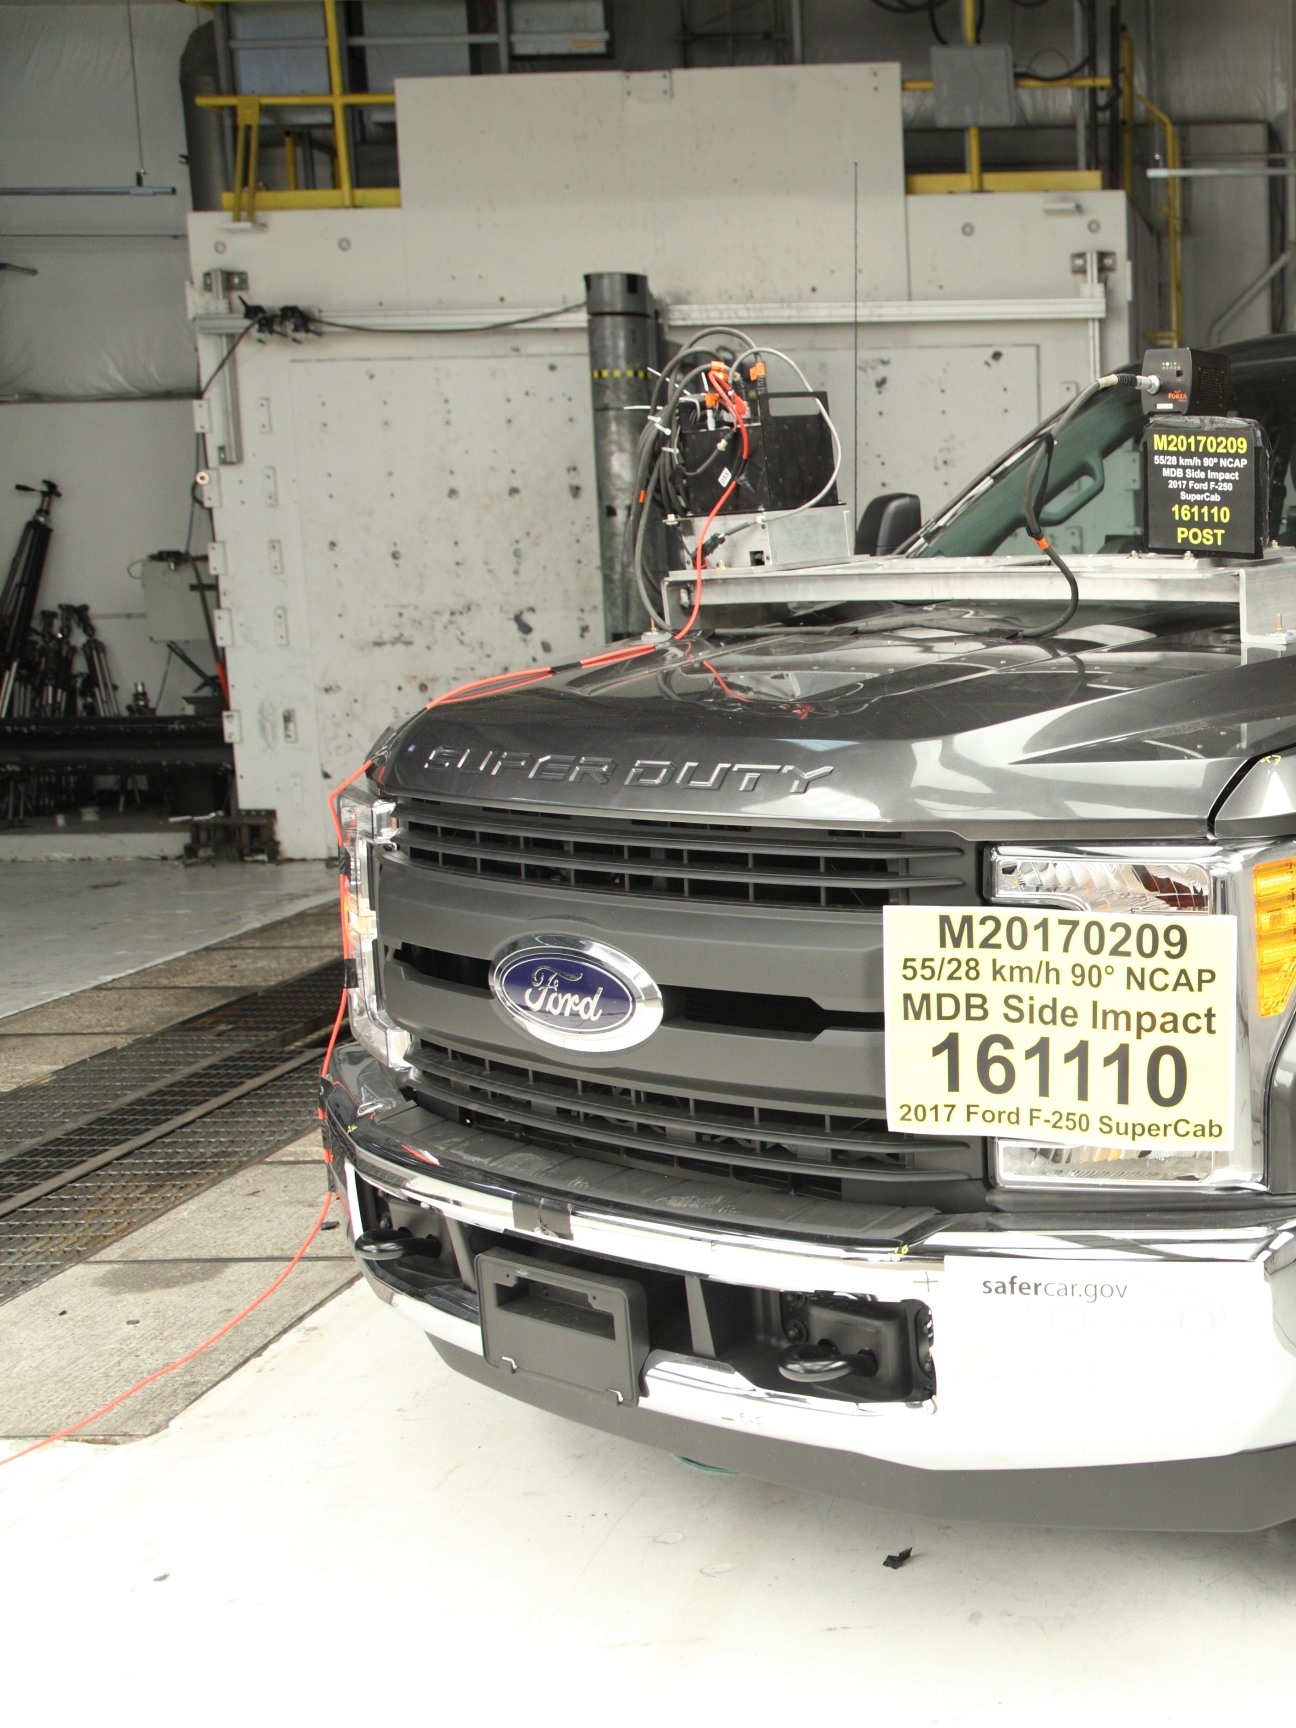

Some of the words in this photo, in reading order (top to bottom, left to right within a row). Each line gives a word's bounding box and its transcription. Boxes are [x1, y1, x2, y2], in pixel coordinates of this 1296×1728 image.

[1153, 434, 1247, 454] M20170209
[1154, 455, 1177, 466] 55/28
[1179, 456, 1201, 467] km/h
[1220, 458, 1247, 468] NCAP
[1162, 468, 1183, 478] MDB
[1185, 469, 1205, 479] Side
[1208, 470, 1239, 481] Impact
[1168, 480, 1186, 489] 2017
[1189, 481, 1208, 490] Ford
[1210, 482, 1233, 491] F-250
[1180, 492, 1220, 502] SuperCab
[1172, 504, 1230, 523] 161110
[1177, 527, 1225, 545] POST
[424, 745, 617, 785] SUPER
[623, 759, 834, 794] DUTY
[938, 914, 1188, 960] M20170209
[901, 957, 981, 981] 55/28
[992, 958, 1060, 985] km/h
[1071, 963, 1115, 988] 90°
[1126, 967, 1217, 992] NCAP
[525, 965, 603, 1021] Ford
[902, 993, 989, 1021] MDB
[1002, 994, 1078, 1028] Side
[1092, 1001, 1217, 1040] Impact
[931, 1032, 1188, 1108] 161110
[899, 1103, 956, 1122] 2017
[966, 1104, 1020, 1126] Ford
[1029, 1109, 1090, 1133] F-250
[1098, 1116, 1223, 1141] SuperCab
[982, 1275, 1128, 1303] safercar.gov
